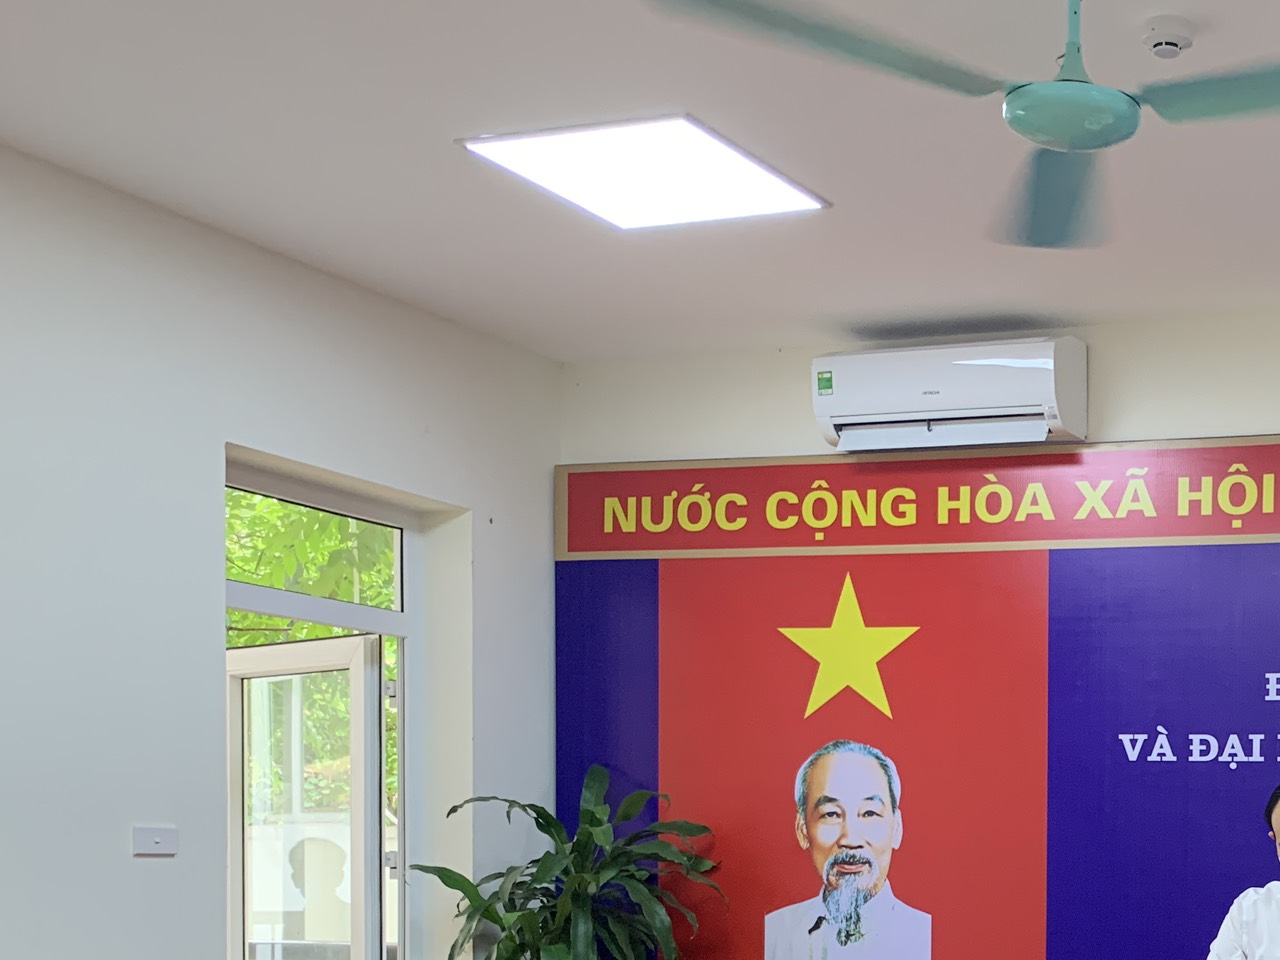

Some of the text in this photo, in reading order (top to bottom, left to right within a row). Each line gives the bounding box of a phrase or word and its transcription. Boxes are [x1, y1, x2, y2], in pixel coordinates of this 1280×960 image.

[603, 483, 748, 535] NƯỚC
[765, 480, 918, 541] CỘNG
[937, 474, 1056, 525] HÒA
[1073, 467, 1157, 521] XÃ
[1177, 463, 1275, 529] HỘI
[1119, 725, 1177, 762] VÀ
[1188, 733, 1264, 770] ĐẠI
